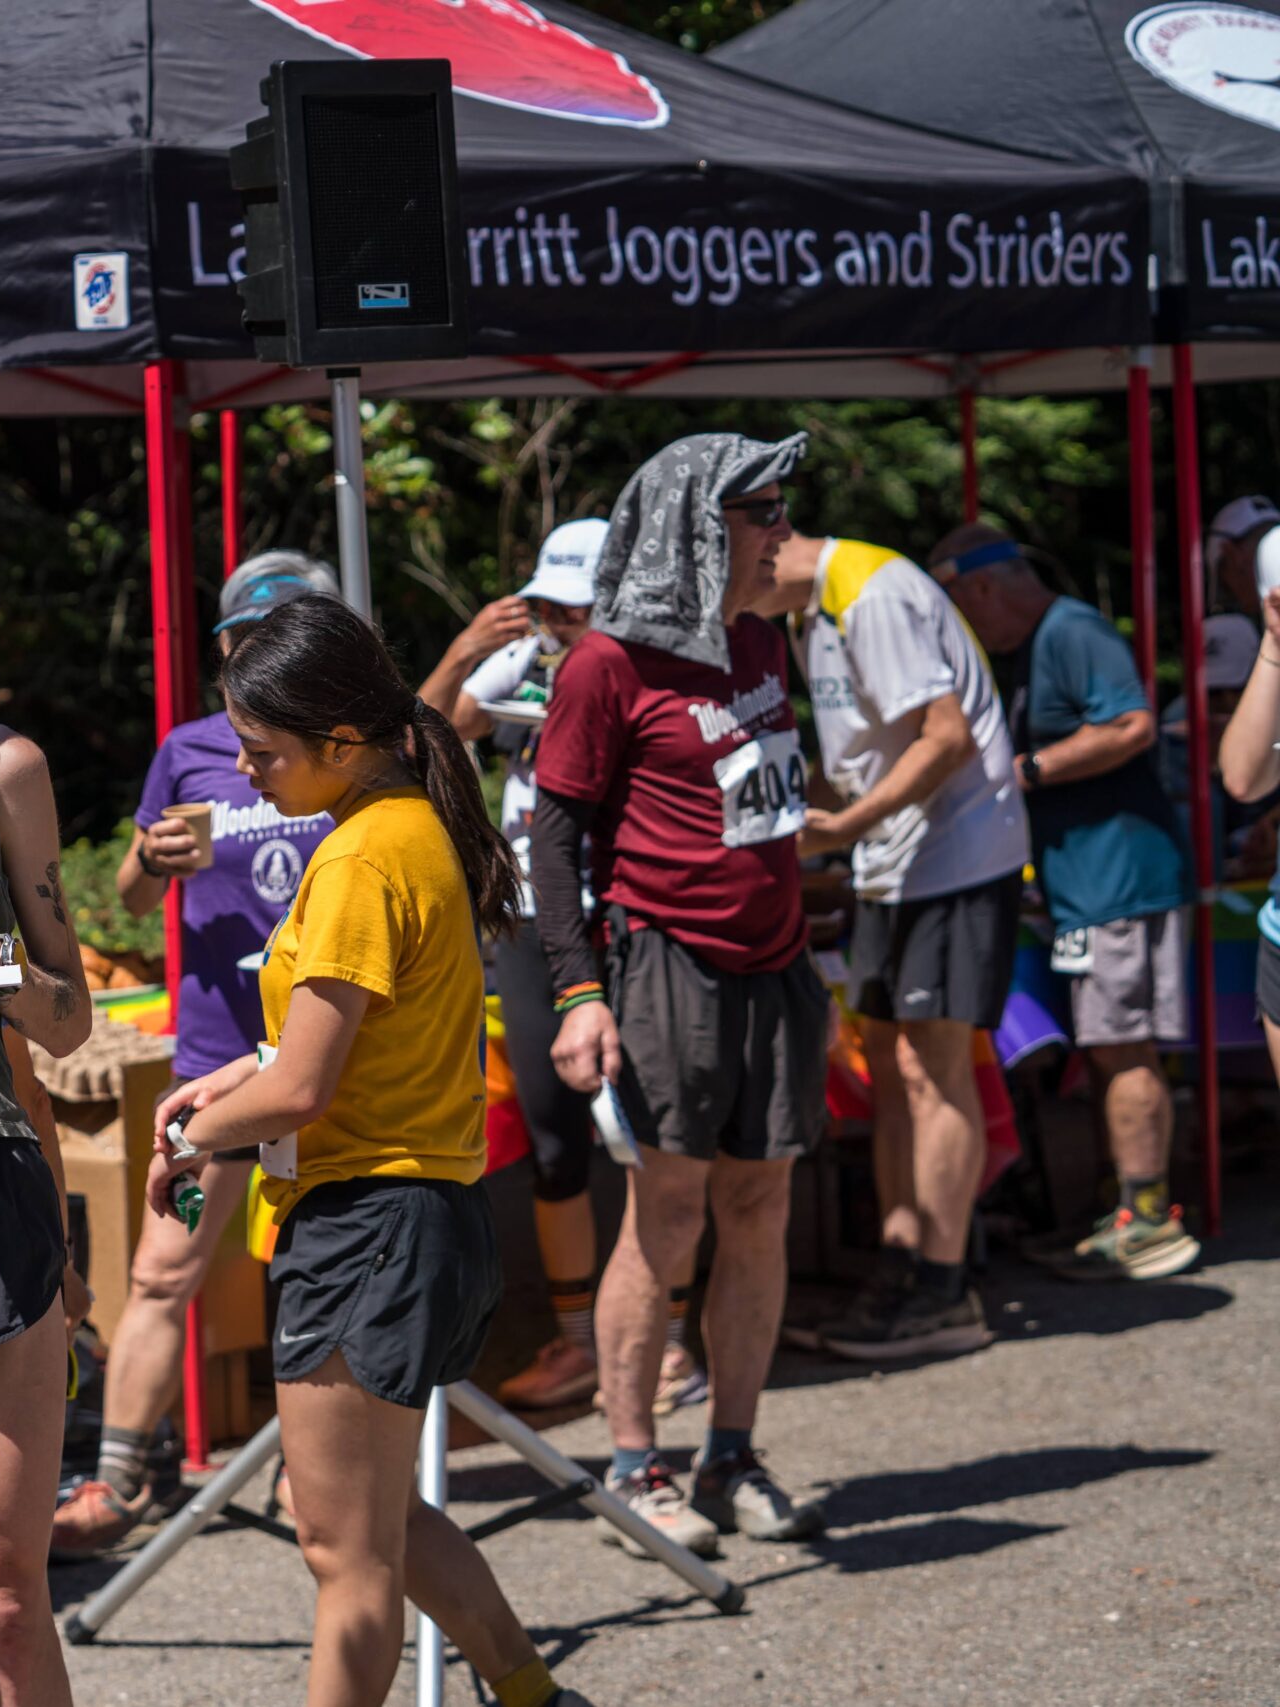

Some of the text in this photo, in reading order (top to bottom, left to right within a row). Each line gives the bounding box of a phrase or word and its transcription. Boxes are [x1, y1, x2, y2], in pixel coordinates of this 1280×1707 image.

[467, 206, 586, 286] rritt
[599, 205, 823, 306] Joggers
[834, 211, 933, 288] and
[946, 211, 1132, 289] Striders
